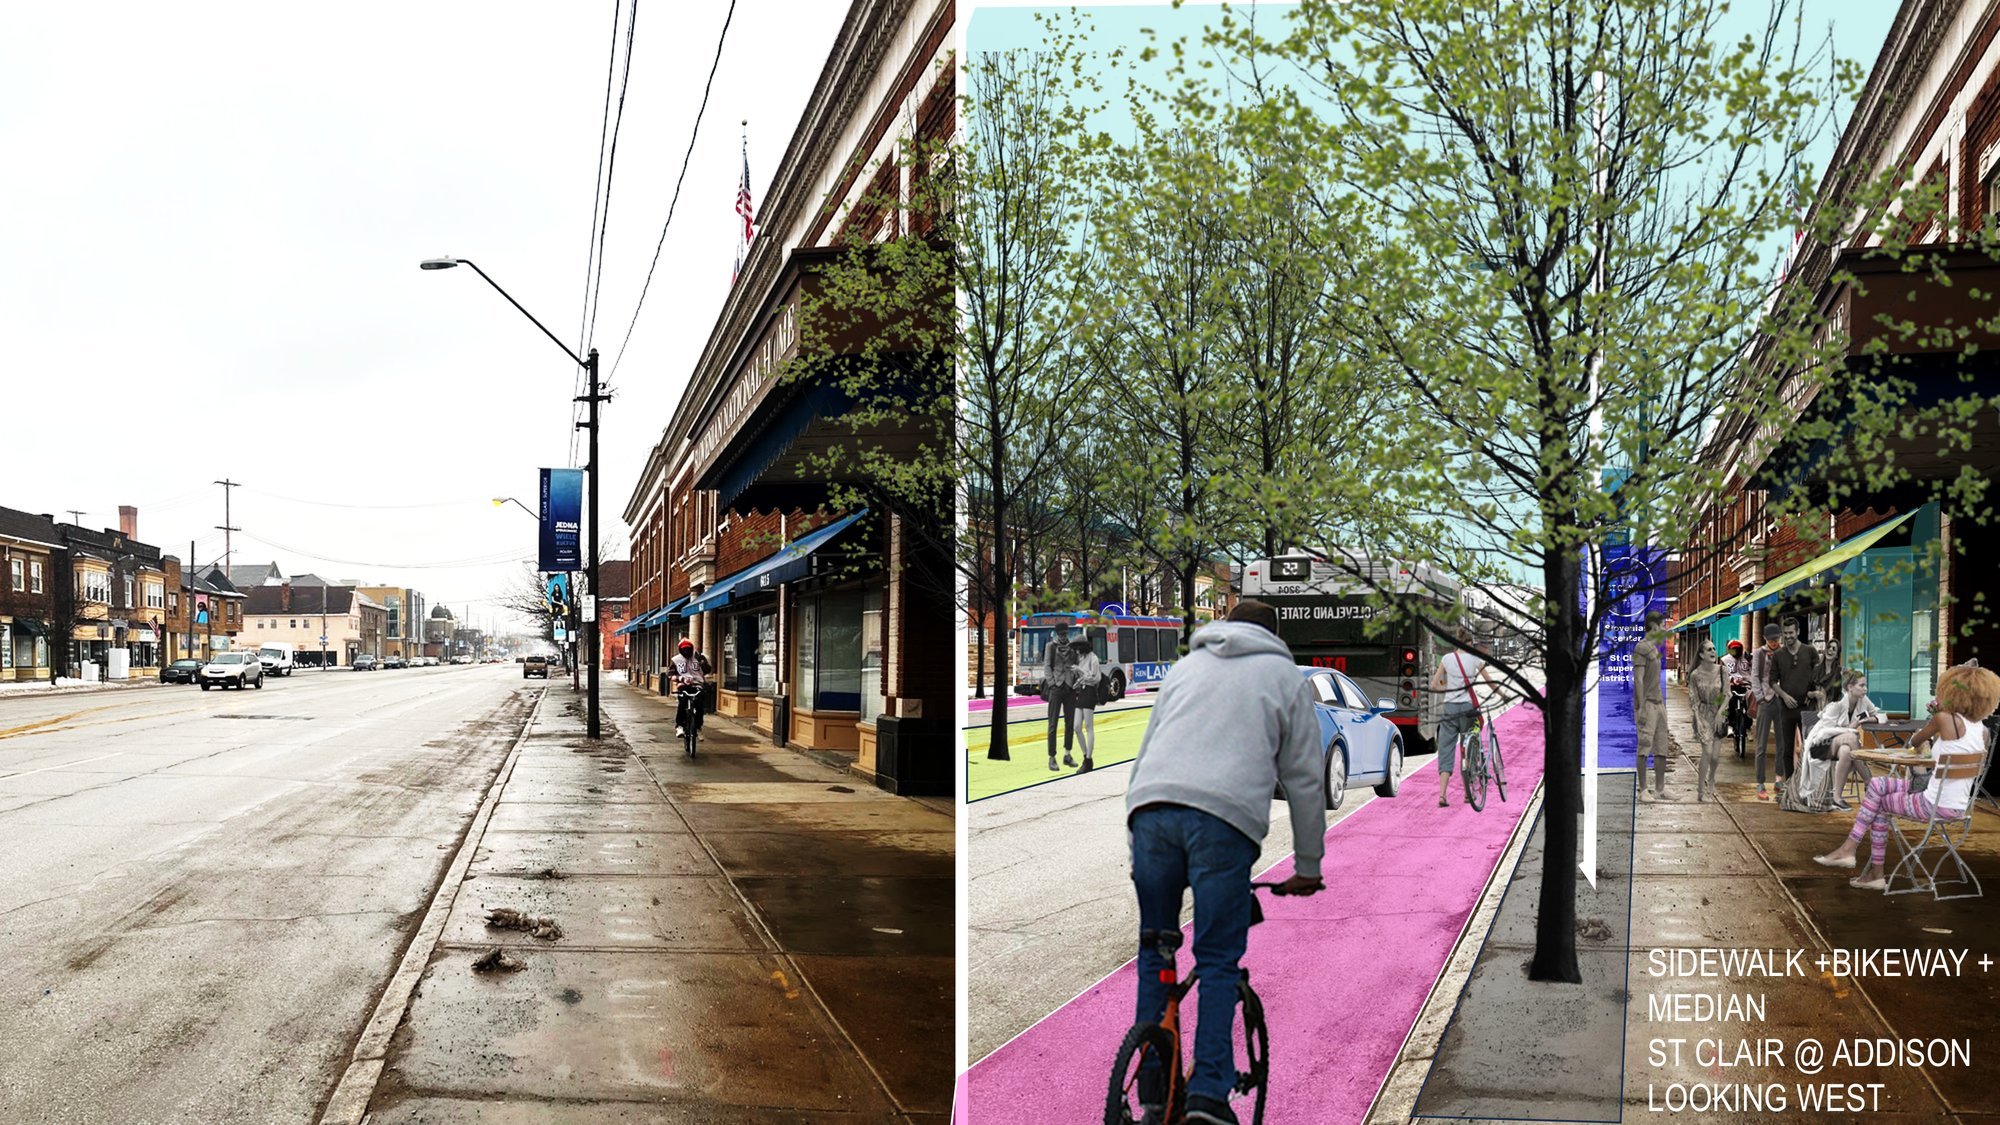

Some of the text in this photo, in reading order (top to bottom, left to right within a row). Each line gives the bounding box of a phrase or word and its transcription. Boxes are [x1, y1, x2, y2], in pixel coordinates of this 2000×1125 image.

[723, 356, 762, 436] NATIONAL
[762, 303, 795, 381] HOME
[555, 521, 578, 529] JEDNA
[1610, 654, 1620, 662] St
[1608, 665, 1634, 674] super
